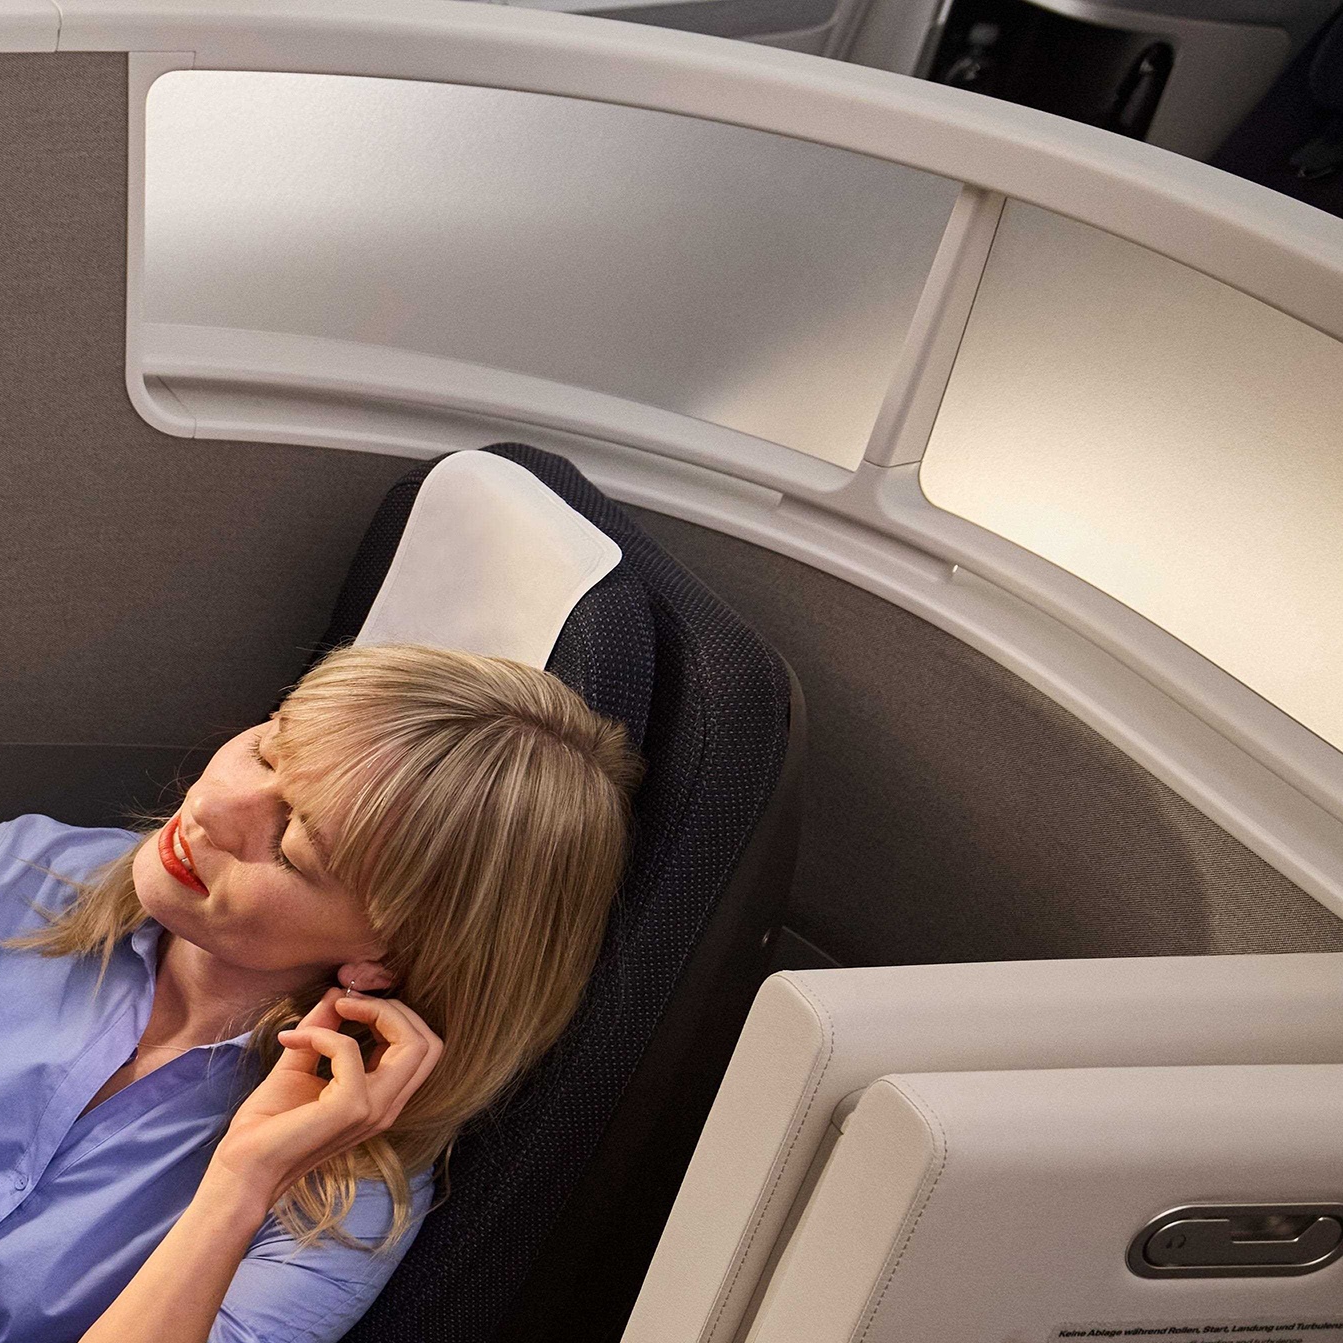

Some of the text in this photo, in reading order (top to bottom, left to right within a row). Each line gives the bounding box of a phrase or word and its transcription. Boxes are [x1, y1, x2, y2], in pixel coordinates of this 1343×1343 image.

[1087, 1329, 1122, 1337] Ablage
[1231, 1324, 1274, 1332] Landung
[1275, 1323, 1295, 1331] und
